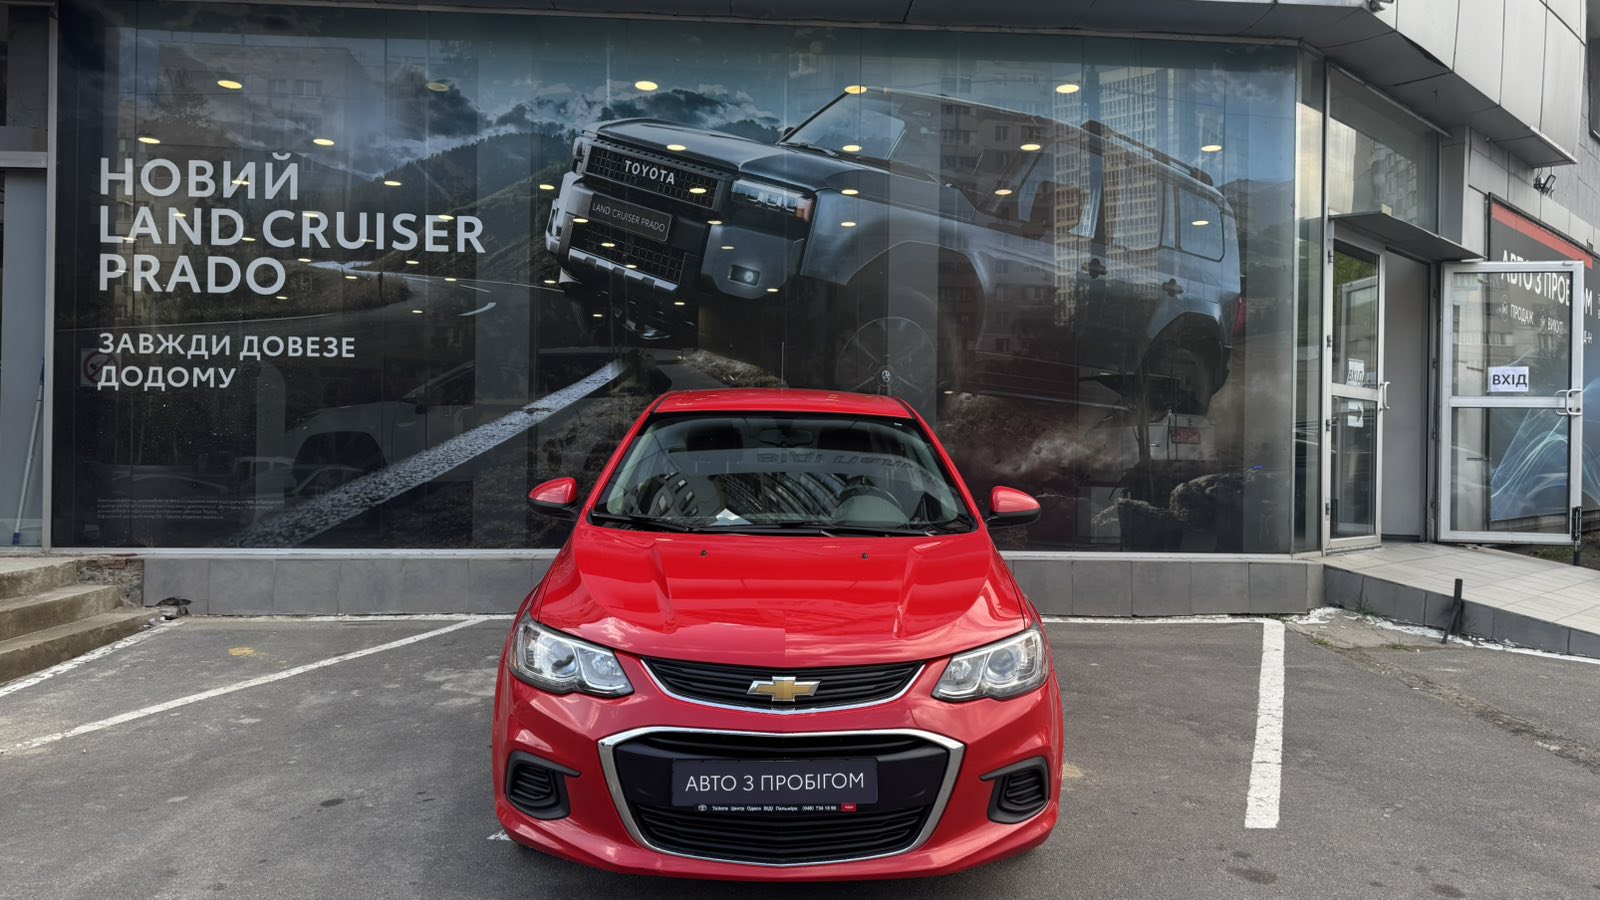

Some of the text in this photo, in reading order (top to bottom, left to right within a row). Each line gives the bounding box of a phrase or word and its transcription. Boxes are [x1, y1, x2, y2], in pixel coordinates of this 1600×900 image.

[99, 152, 299, 200] НОВИЙ
[624, 159, 675, 185] TOYOTA
[99, 205, 486, 254] LAND CRUISER
[592, 202, 665, 232] LAND CRUISER PRADO
[99, 253, 286, 295] PRADO
[98, 332, 355, 360] ЗАВЖДИ ДОВЕЗЕ
[97, 365, 236, 391] ДОДОМУ
[1492, 374, 1527, 388] ВХІД
[685, 775, 737, 792] АВТО
[760, 772, 864, 791] ПРОБІГОМ
